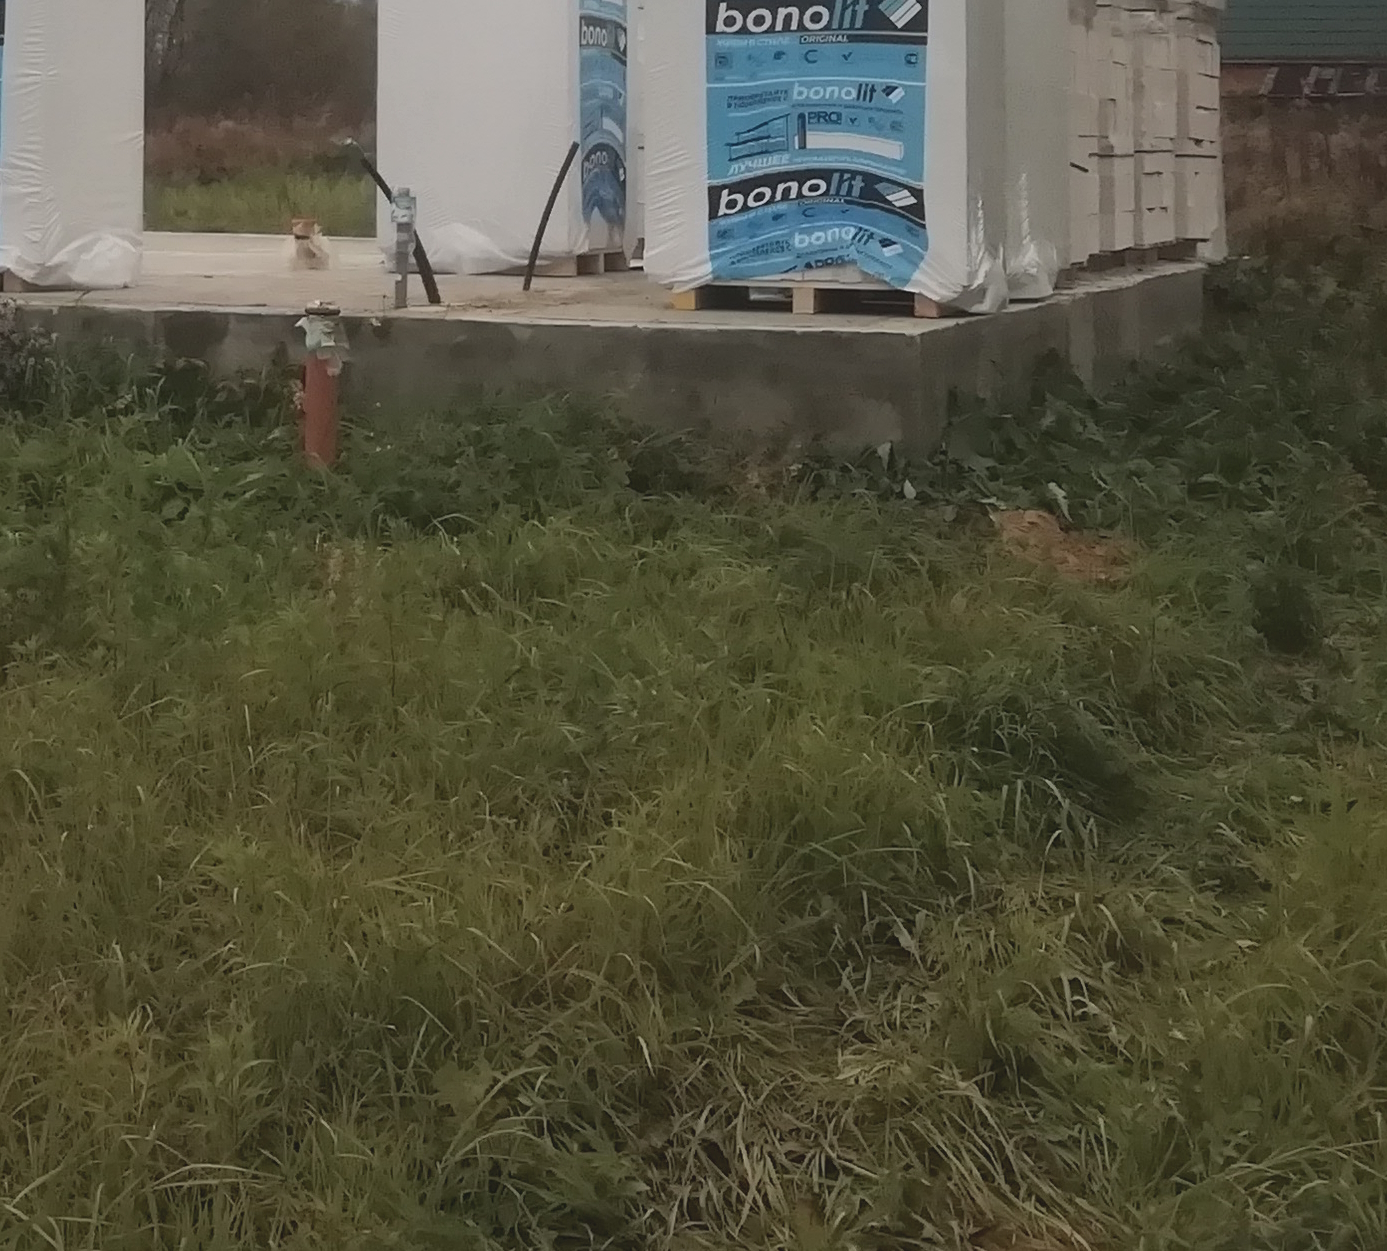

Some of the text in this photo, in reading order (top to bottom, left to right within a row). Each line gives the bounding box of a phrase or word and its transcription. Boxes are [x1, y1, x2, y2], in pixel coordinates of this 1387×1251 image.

[801, 35, 849, 43] ORIGINAL
[793, 82, 876, 103] bonolit
[727, 154, 790, 176] ЛУЧШЕЕ
[717, 172, 865, 217] bonolit
[794, 226, 875, 248] bonolit
